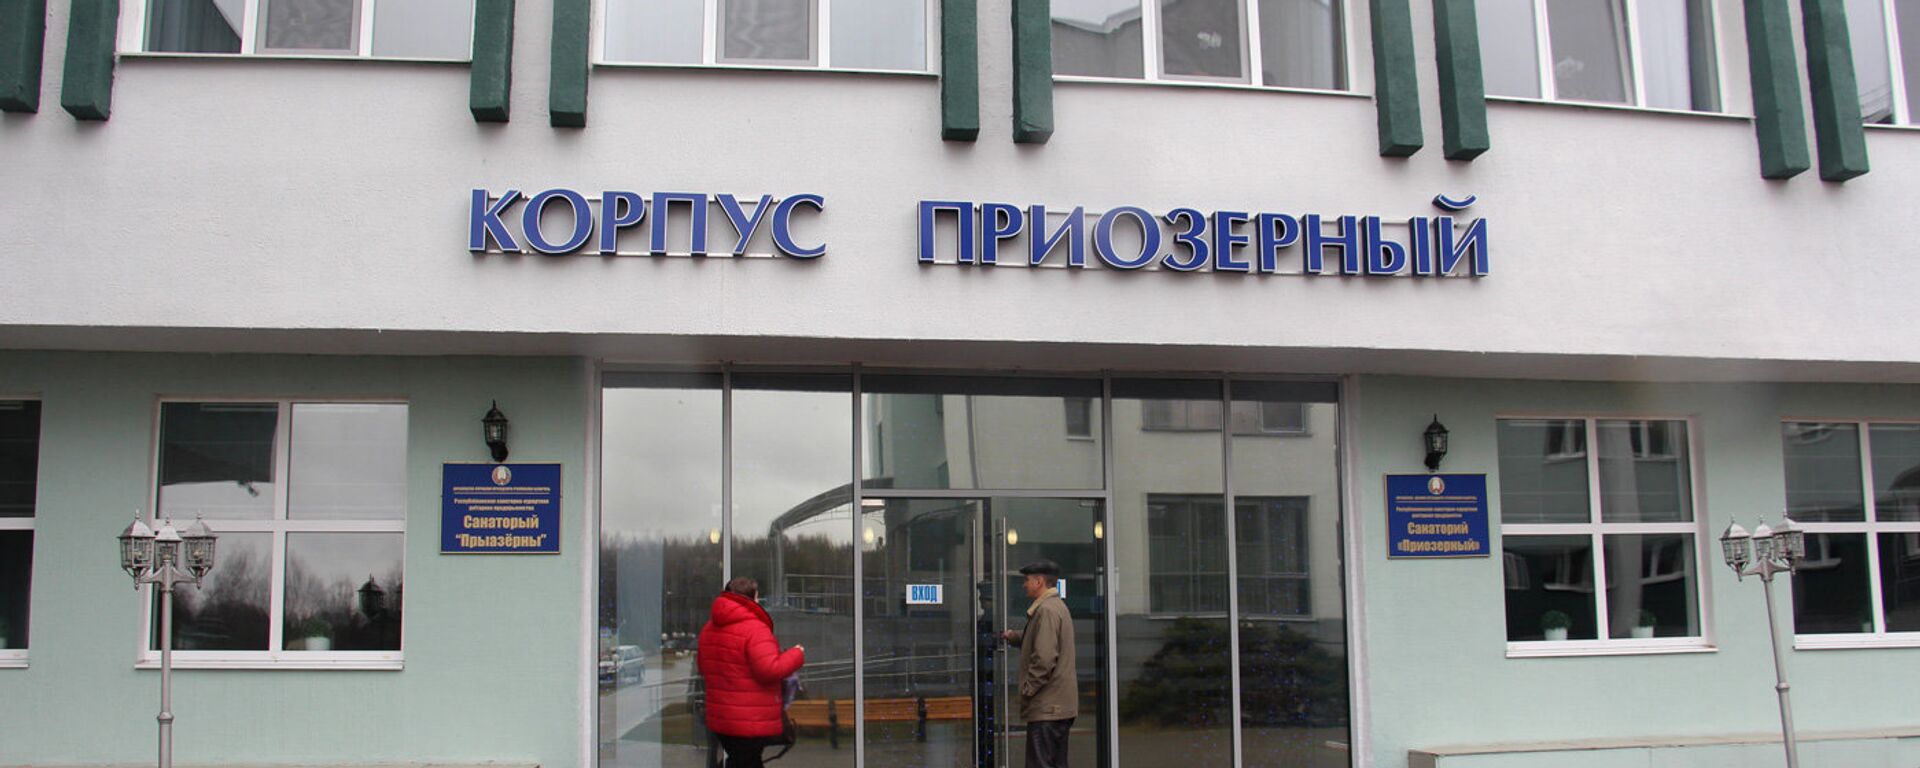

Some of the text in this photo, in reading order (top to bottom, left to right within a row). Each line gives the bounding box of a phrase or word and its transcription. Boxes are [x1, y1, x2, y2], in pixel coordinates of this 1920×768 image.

[468, 188, 1490, 277] КОРПУС ПРИОЗЕРНЫЙ
[1407, 521, 1469, 535] Санаторий
[911, 585, 938, 602] ВХОД
